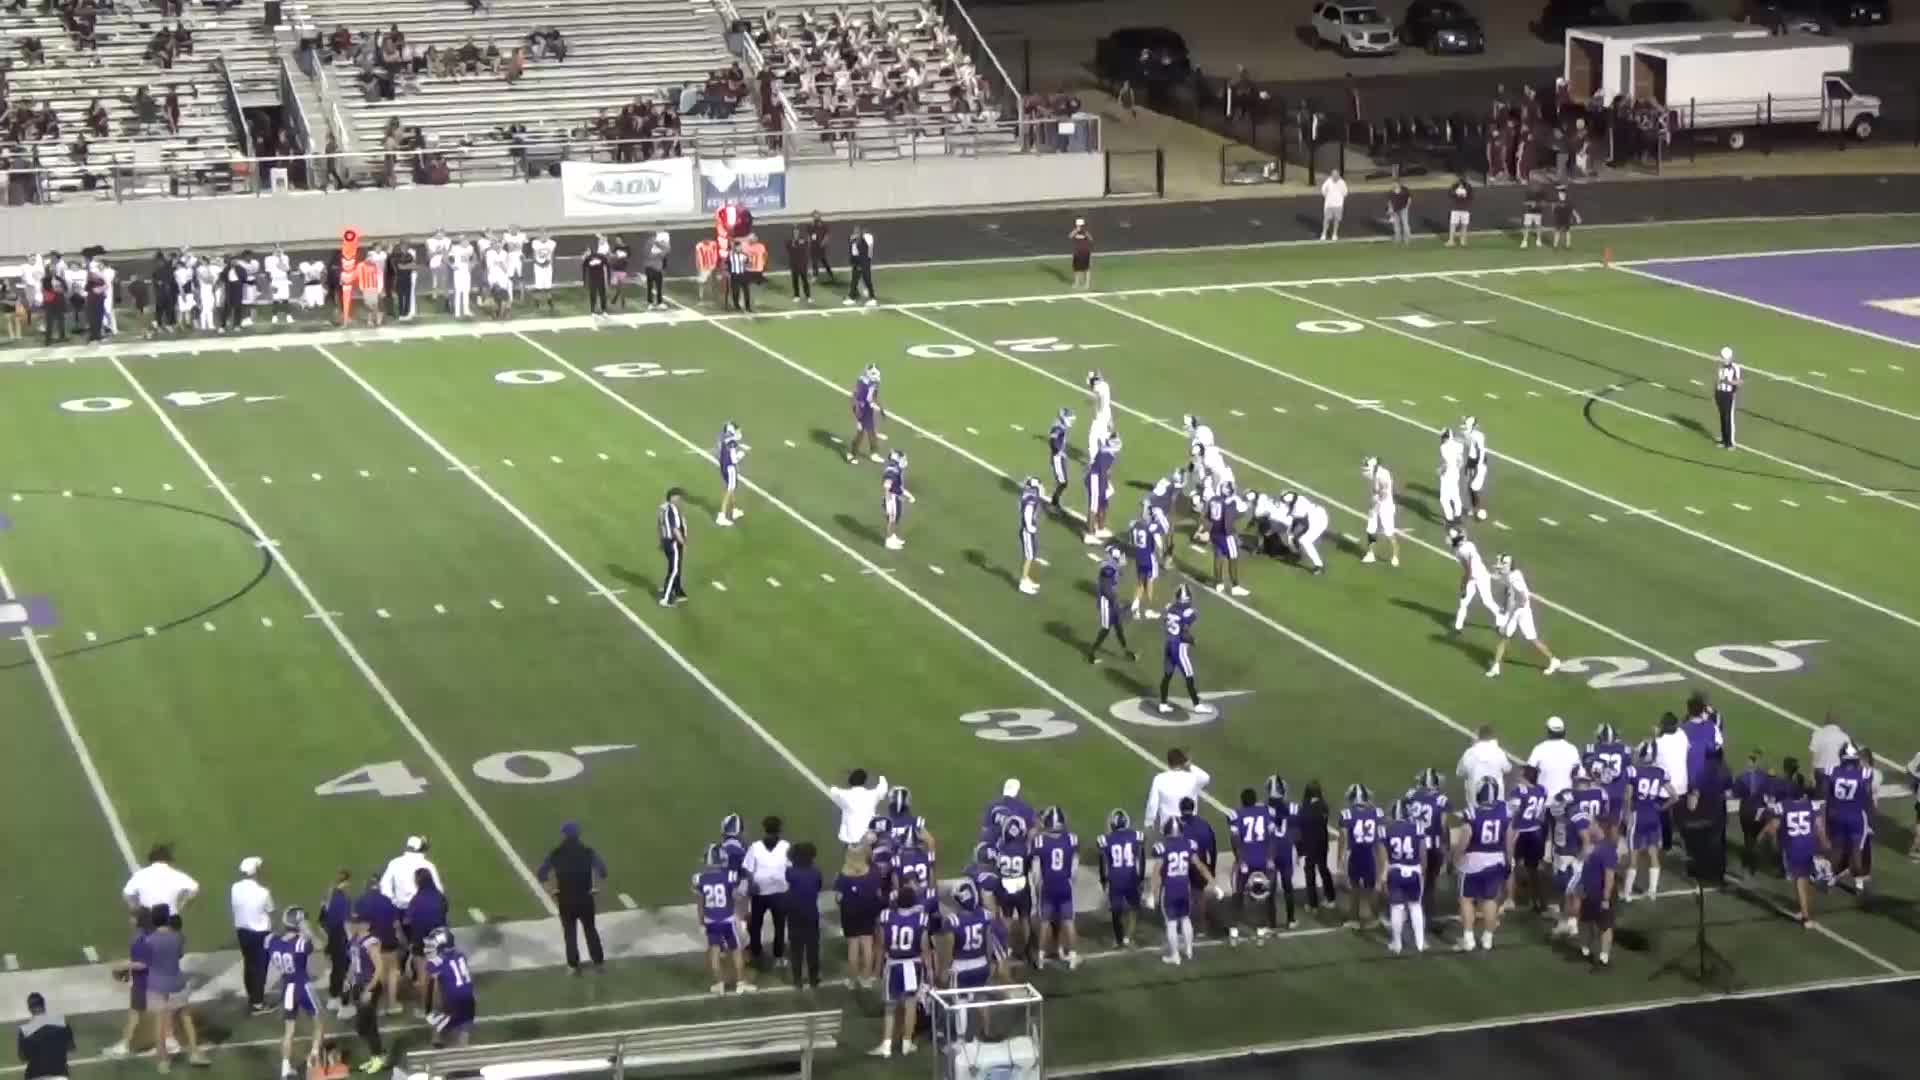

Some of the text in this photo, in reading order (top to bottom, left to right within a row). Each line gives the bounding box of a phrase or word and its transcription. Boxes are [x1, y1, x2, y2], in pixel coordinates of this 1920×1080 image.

[1834, 778, 1858, 800] 67
[1243, 816, 1265, 843] 74
[1352, 819, 1376, 844] 43
[1480, 820, 1501, 844] 61
[1786, 811, 1811, 836] 55
[1389, 835, 1414, 860] 34
[1167, 851, 1189, 877] 26
[702, 883, 727, 909] 28
[890, 924, 914, 950] 10
[963, 923, 984, 950] 15
